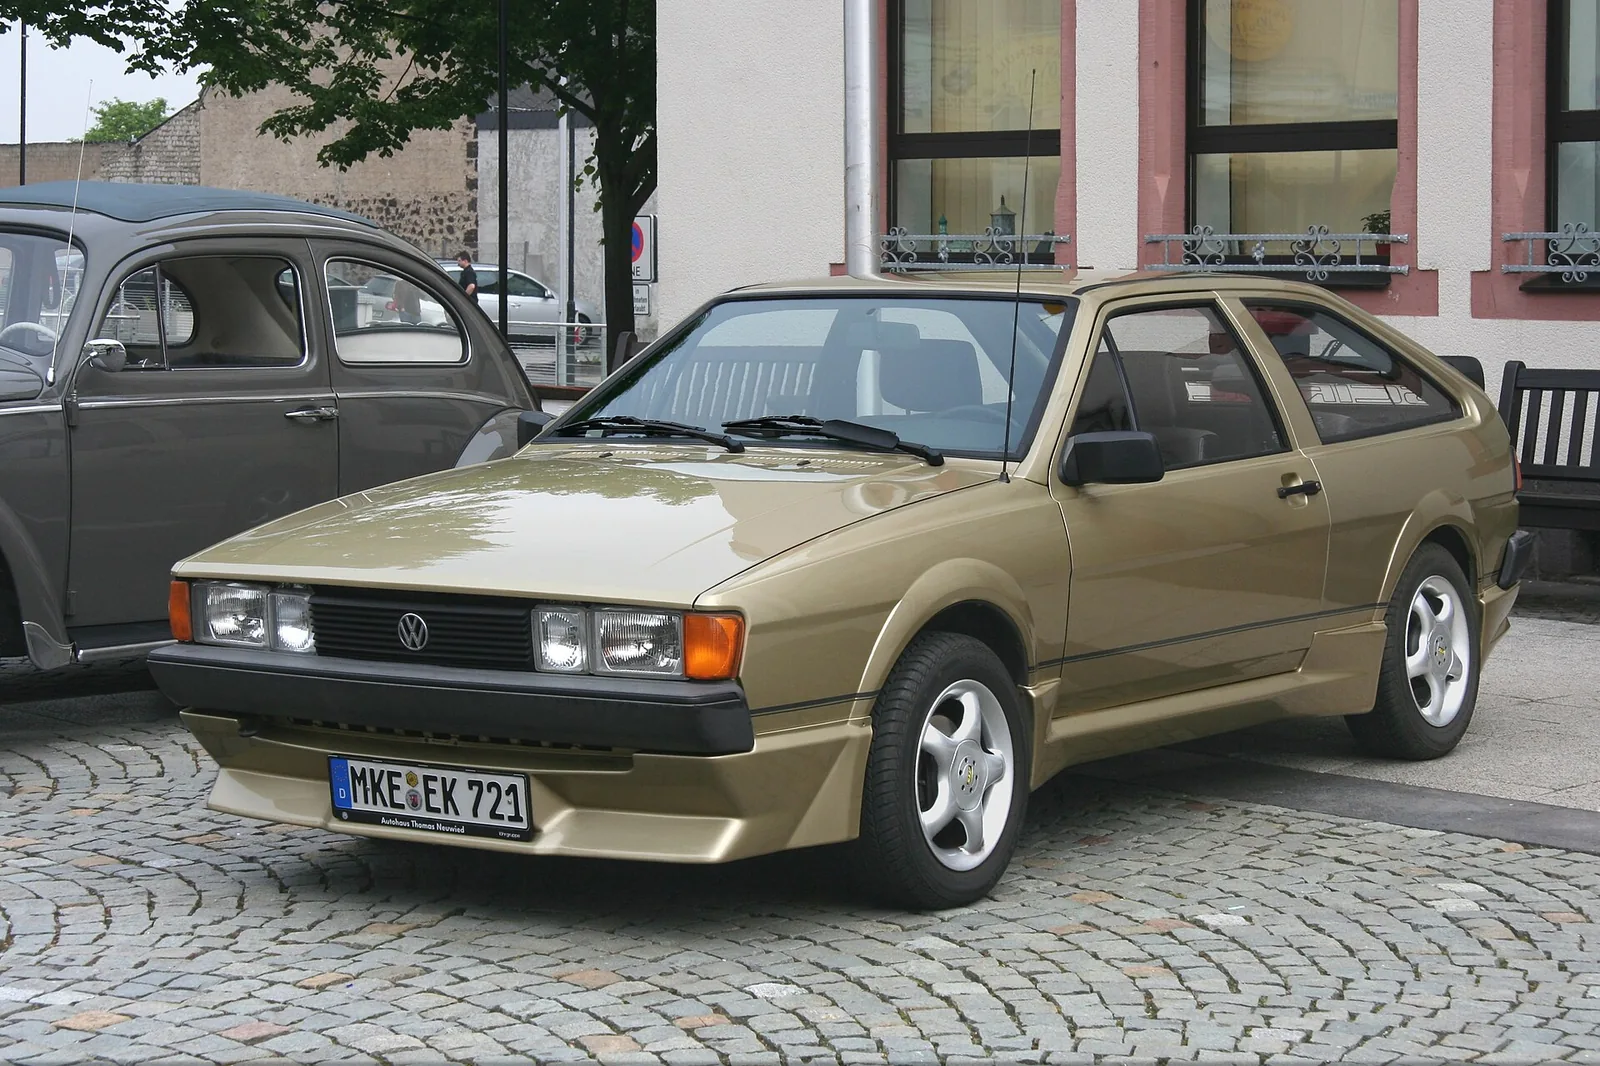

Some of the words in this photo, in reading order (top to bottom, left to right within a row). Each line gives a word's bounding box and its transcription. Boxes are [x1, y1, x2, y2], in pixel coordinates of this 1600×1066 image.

[398, 613, 428, 650] VW
[339, 788, 346, 799] D
[350, 765, 406, 810] MKE
[422, 774, 460, 816] EK
[467, 779, 524, 823] 721
[381, 816, 410, 828] Autohaus
[411, 820, 435, 831] Thomas
[436, 823, 465, 834] Neuwied
